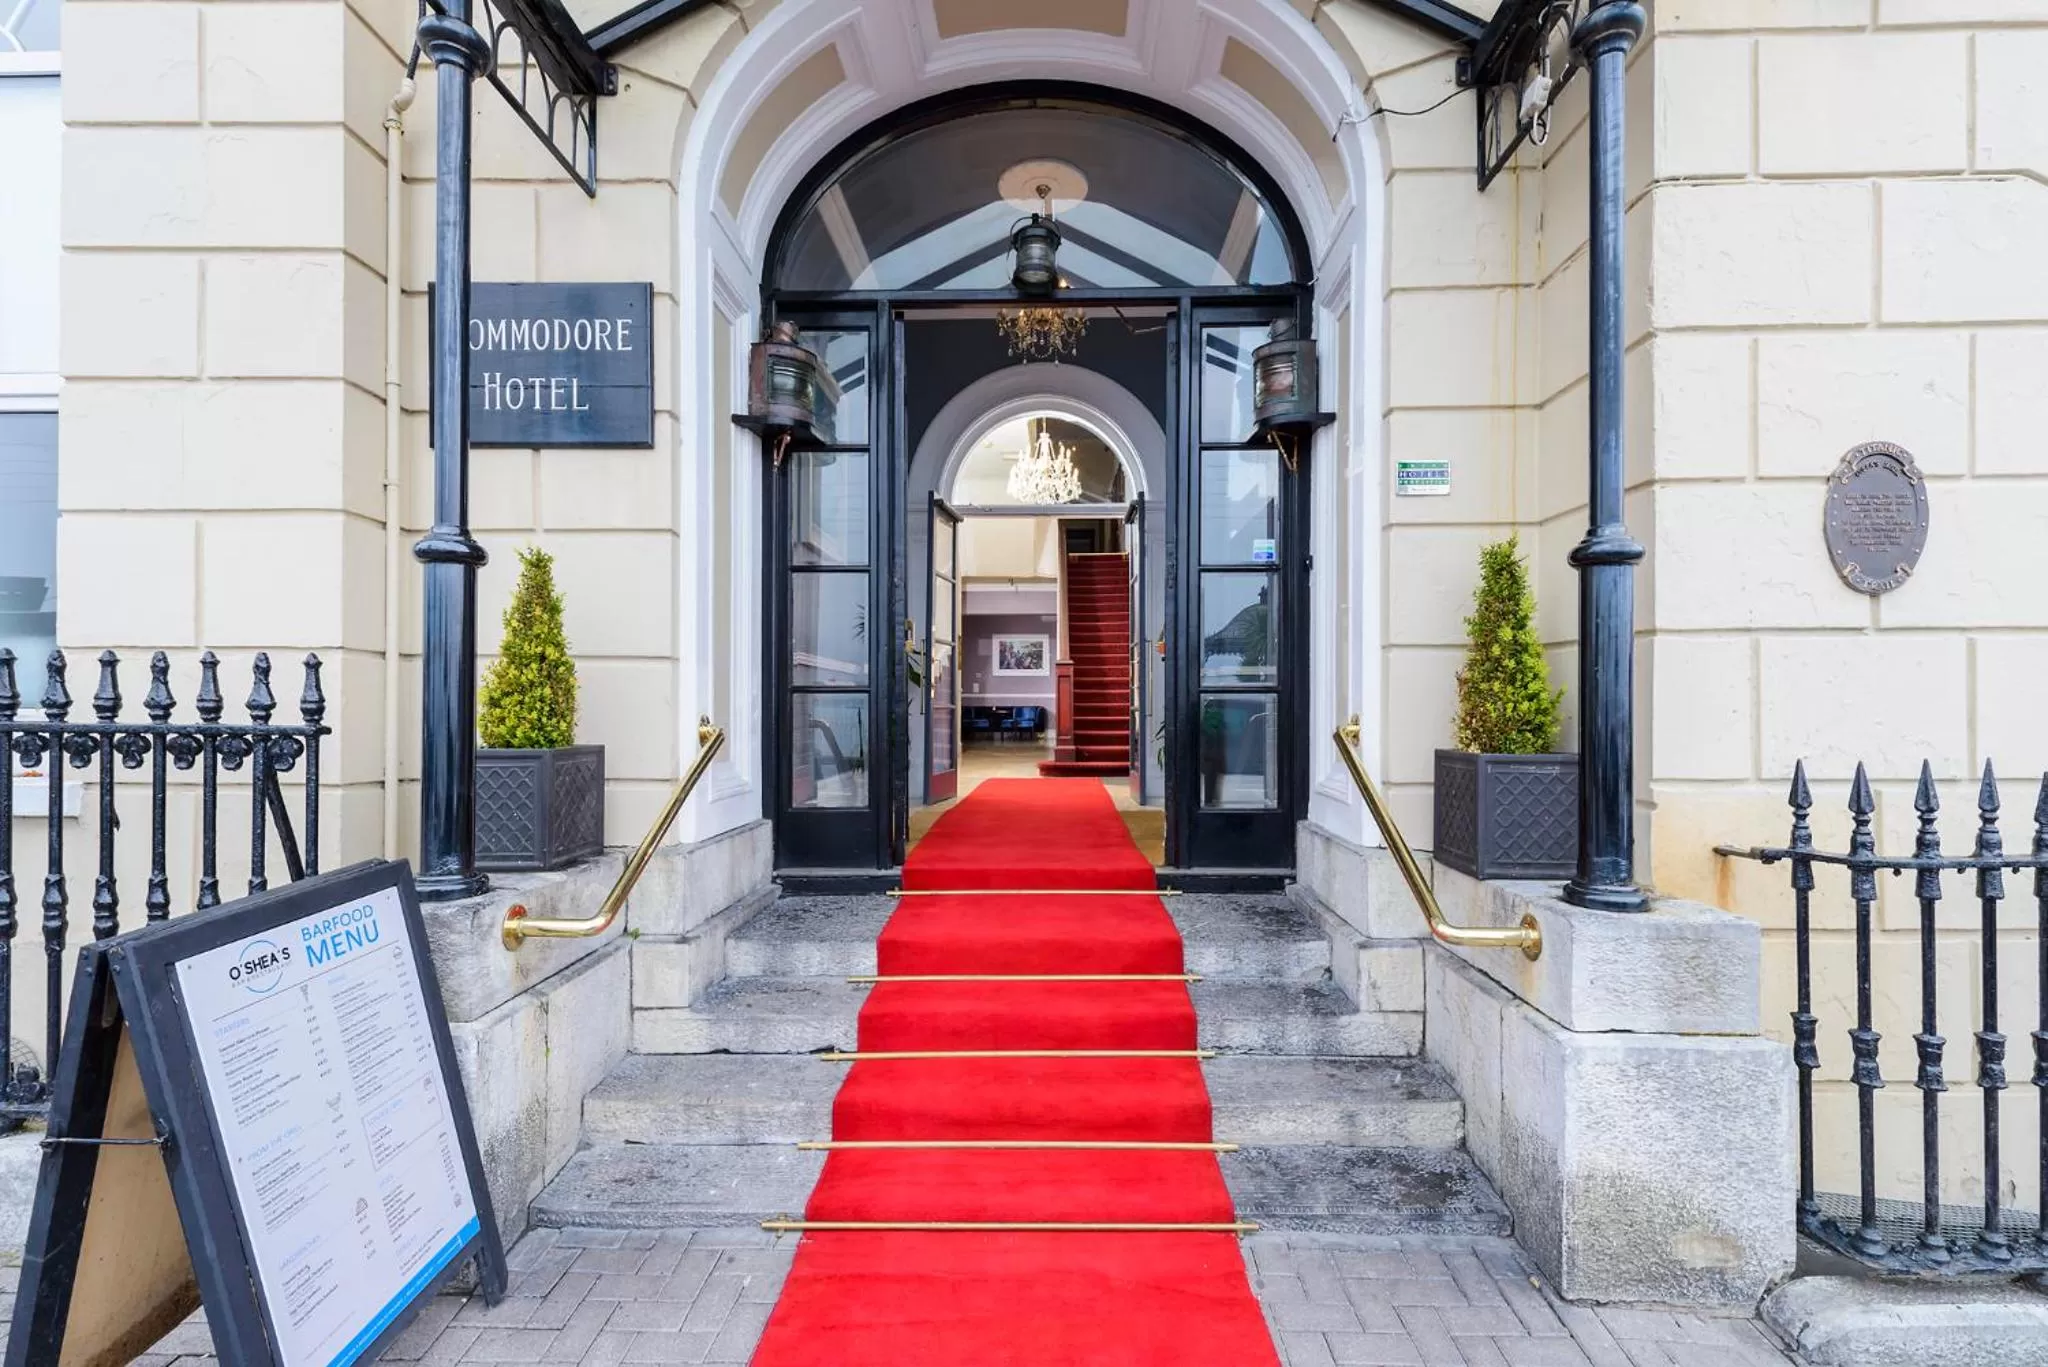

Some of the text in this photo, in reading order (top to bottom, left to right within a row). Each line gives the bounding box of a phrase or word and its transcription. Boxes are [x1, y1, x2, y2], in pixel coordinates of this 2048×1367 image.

[469, 319, 633, 351] OMMODORE
[483, 372, 589, 410] HOTEL
[301, 904, 374, 942] BARFOOD
[305, 919, 379, 968] MENU
[228, 946, 291, 981] O'SHEA'S
